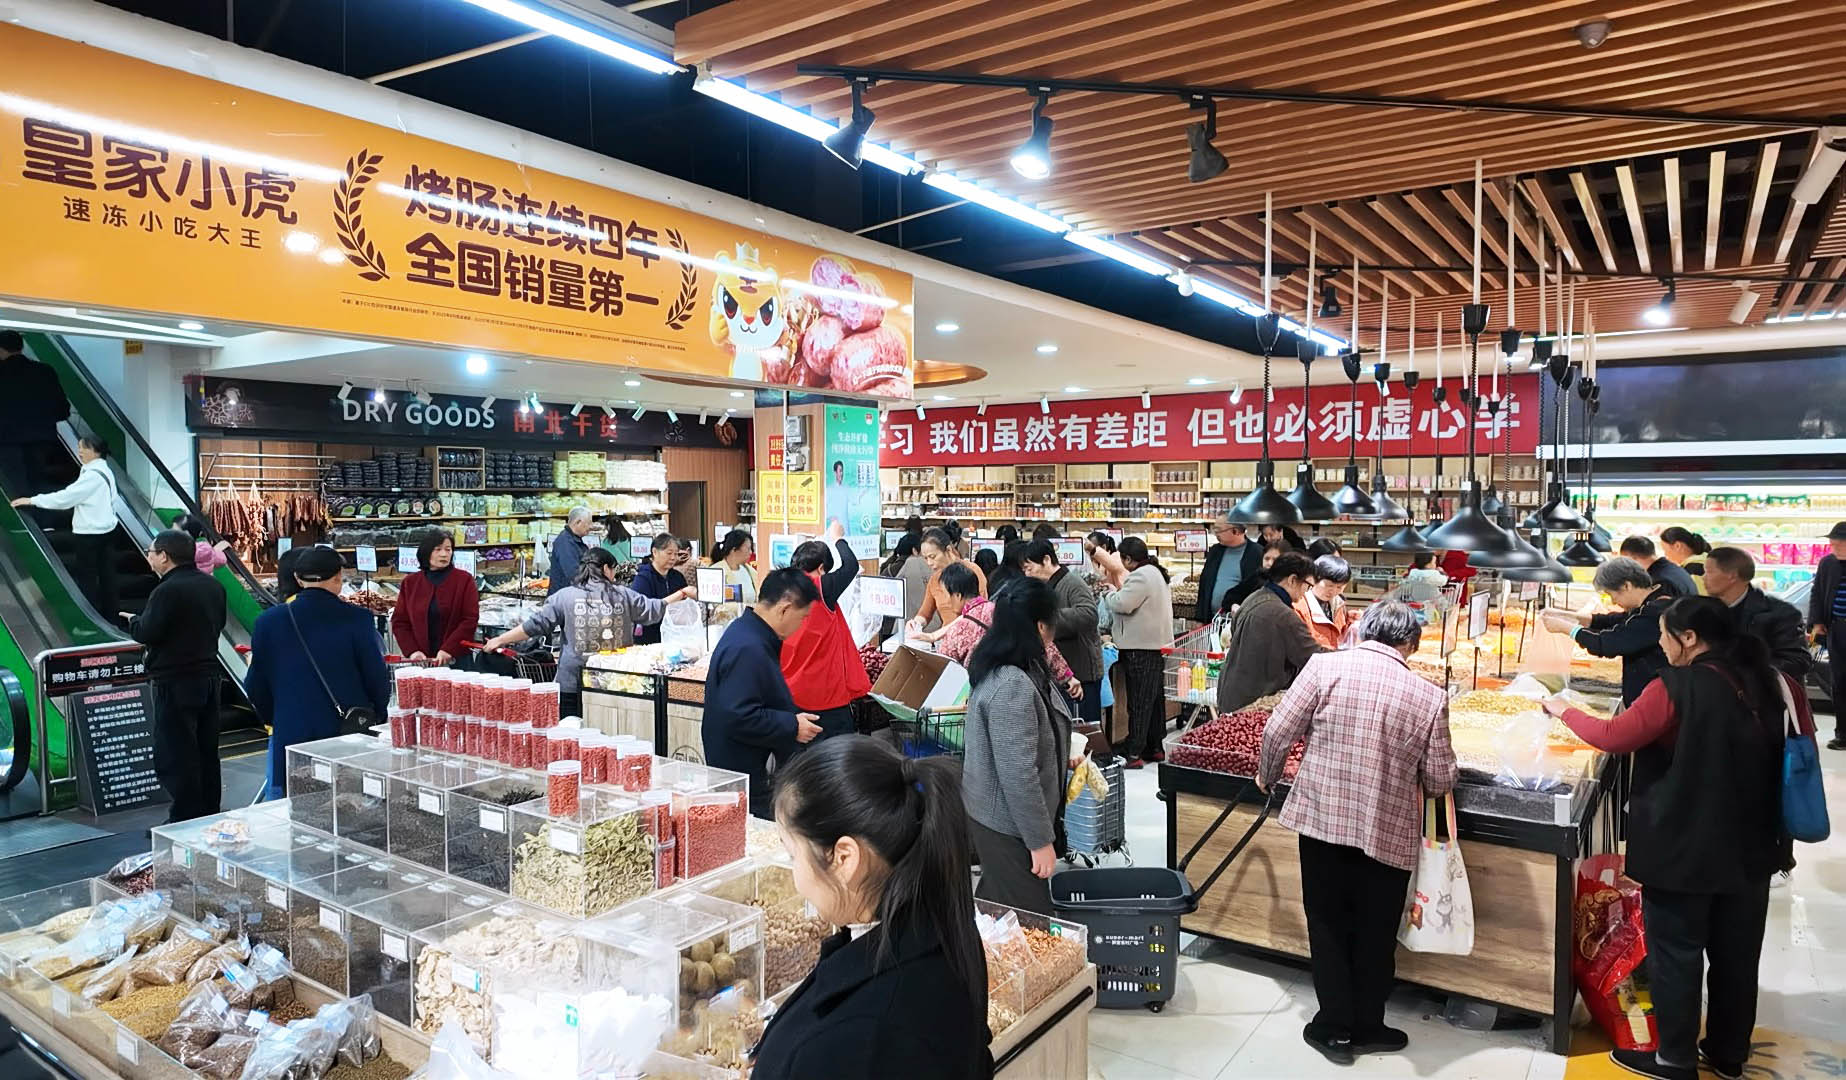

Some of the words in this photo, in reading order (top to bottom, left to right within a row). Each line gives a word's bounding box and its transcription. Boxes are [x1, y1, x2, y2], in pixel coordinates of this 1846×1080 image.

[22, 117, 298, 225] 皇家小虎
[63, 196, 262, 248] 速冻小吃大王
[404, 164, 660, 268] 烤肠连续四年
[406, 232, 660, 316] 全国销量第一
[343, 401, 397, 423] DRY
[405, 403, 496, 428] GOODS
[513, 409, 619, 438] 南北干货
[929, 411, 1168, 455] 我们虽然有差距
[1186, 393, 1521, 447] 但也必须虚心学
[767, 494, 813, 504] 内有控探头
[767, 505, 814, 515] 请您心购物
[52, 663, 145, 684] 购物车请勿上三楼
